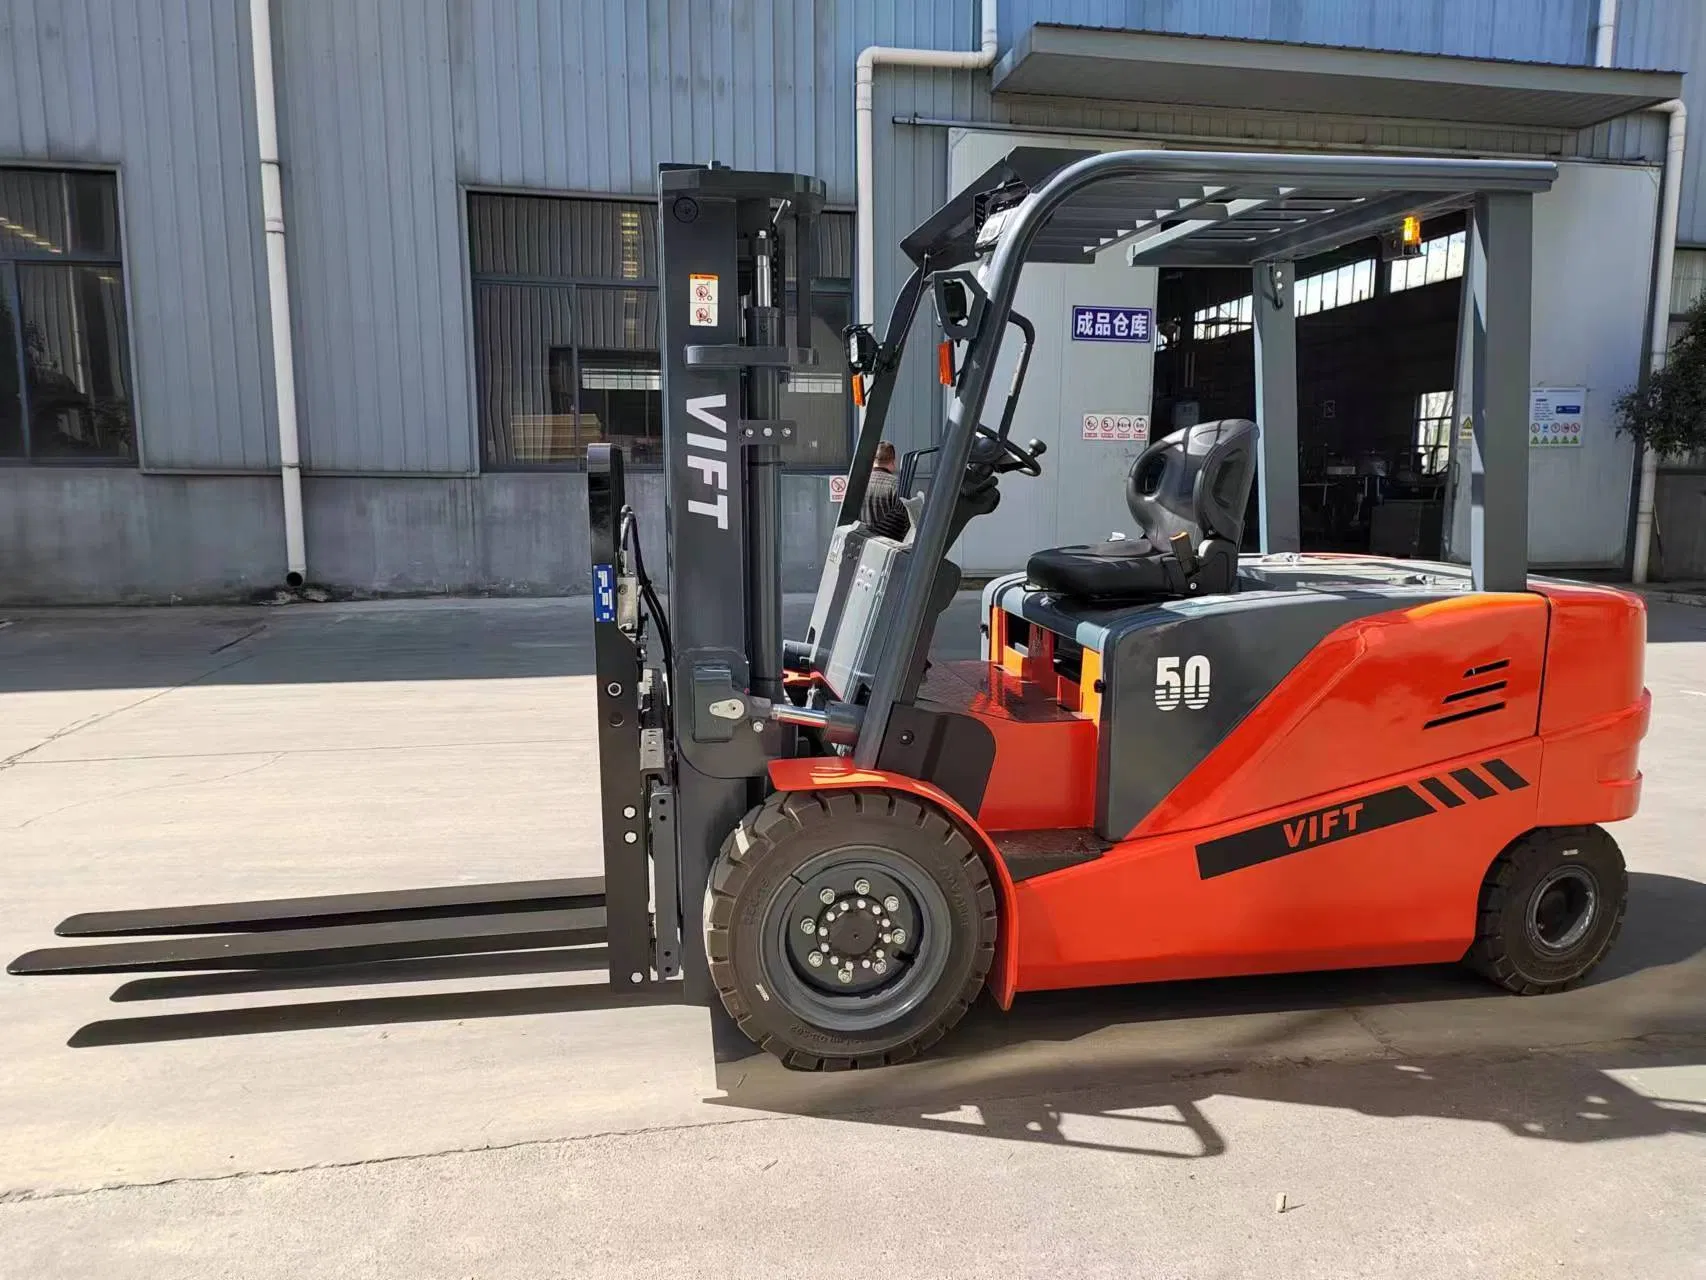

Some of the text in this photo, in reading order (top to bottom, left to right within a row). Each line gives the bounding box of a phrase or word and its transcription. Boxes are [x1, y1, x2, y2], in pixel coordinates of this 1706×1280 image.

[1076, 311, 1148, 338] 成品仓库
[686, 393, 728, 530] VIFT
[1154, 654, 1211, 711] 50
[1283, 802, 1364, 848] VIFT
